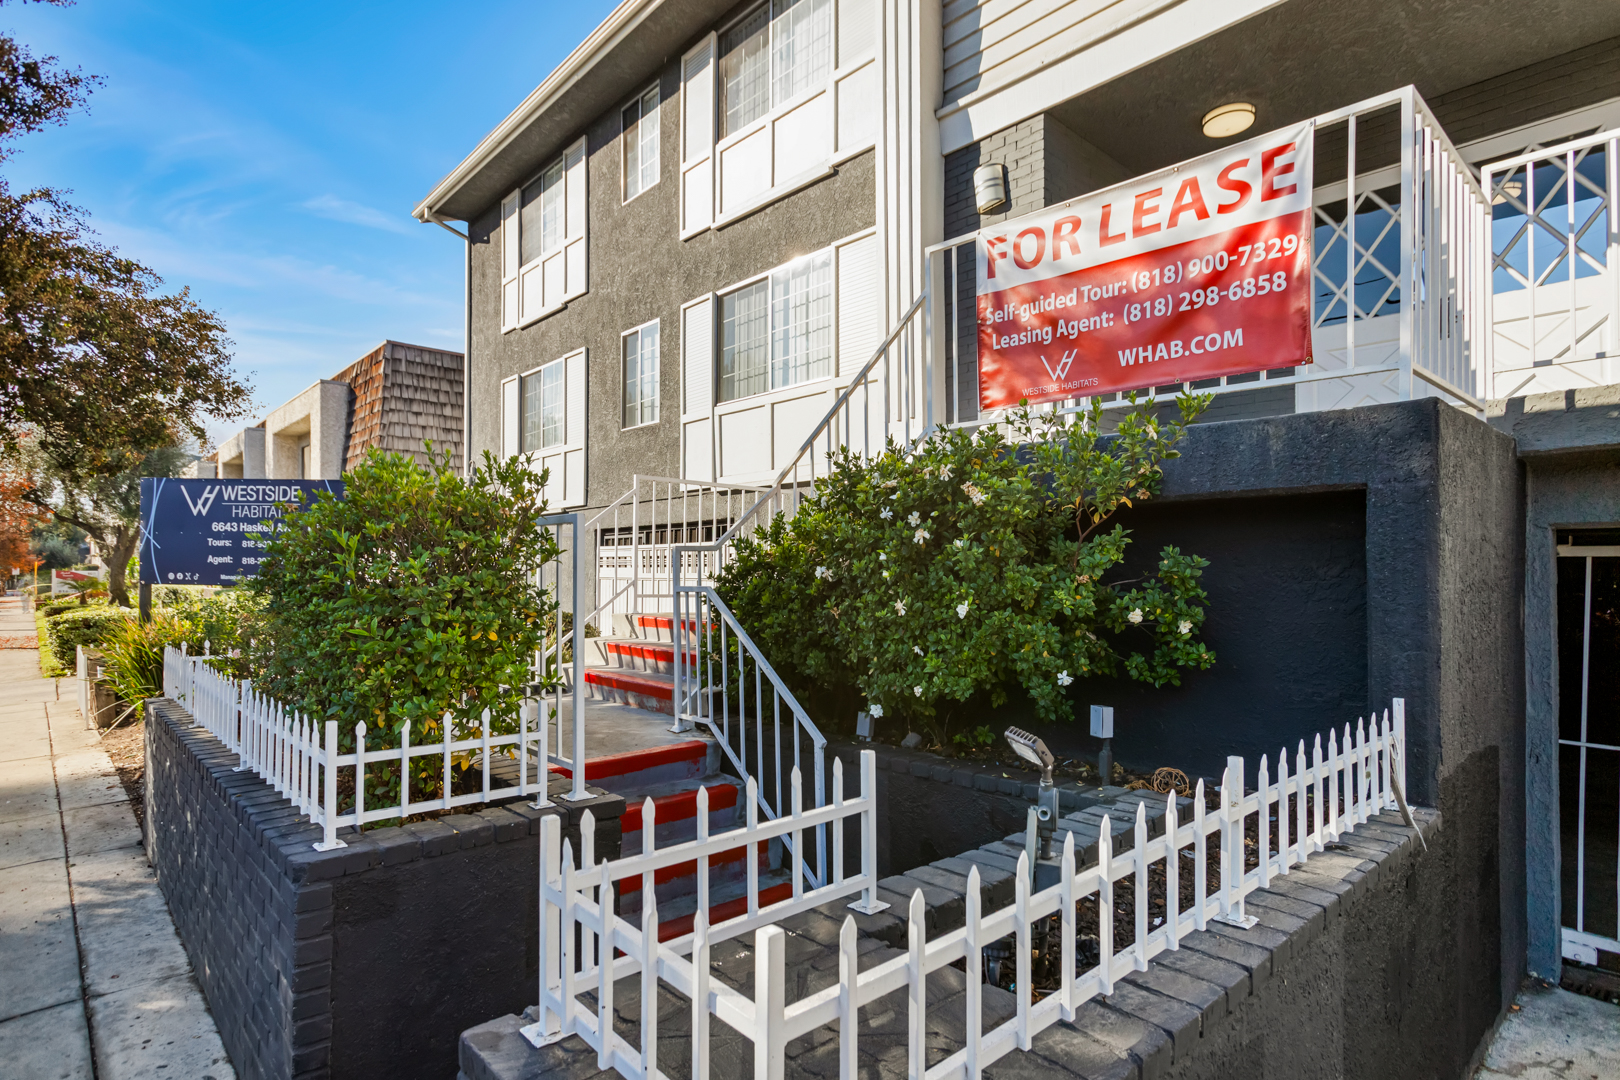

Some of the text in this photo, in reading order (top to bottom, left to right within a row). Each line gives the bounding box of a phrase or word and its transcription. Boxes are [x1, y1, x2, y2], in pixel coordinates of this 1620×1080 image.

[986, 141, 1298, 280] FOR LEASE
[985, 233, 1298, 325] Self-guided Tour: (818) 900-7329
[992, 271, 1288, 350] Leasing Agent: (818) 298-6858
[1117, 328, 1244, 367] WHAB.COM
[1022, 377, 1099, 397] WESTSIDE HABITATS
[222, 485, 300, 502] WESTSIDE
[211, 522, 238, 532] 6643
[207, 538, 232, 547] Tours:
[207, 555, 233, 565] Agent:
